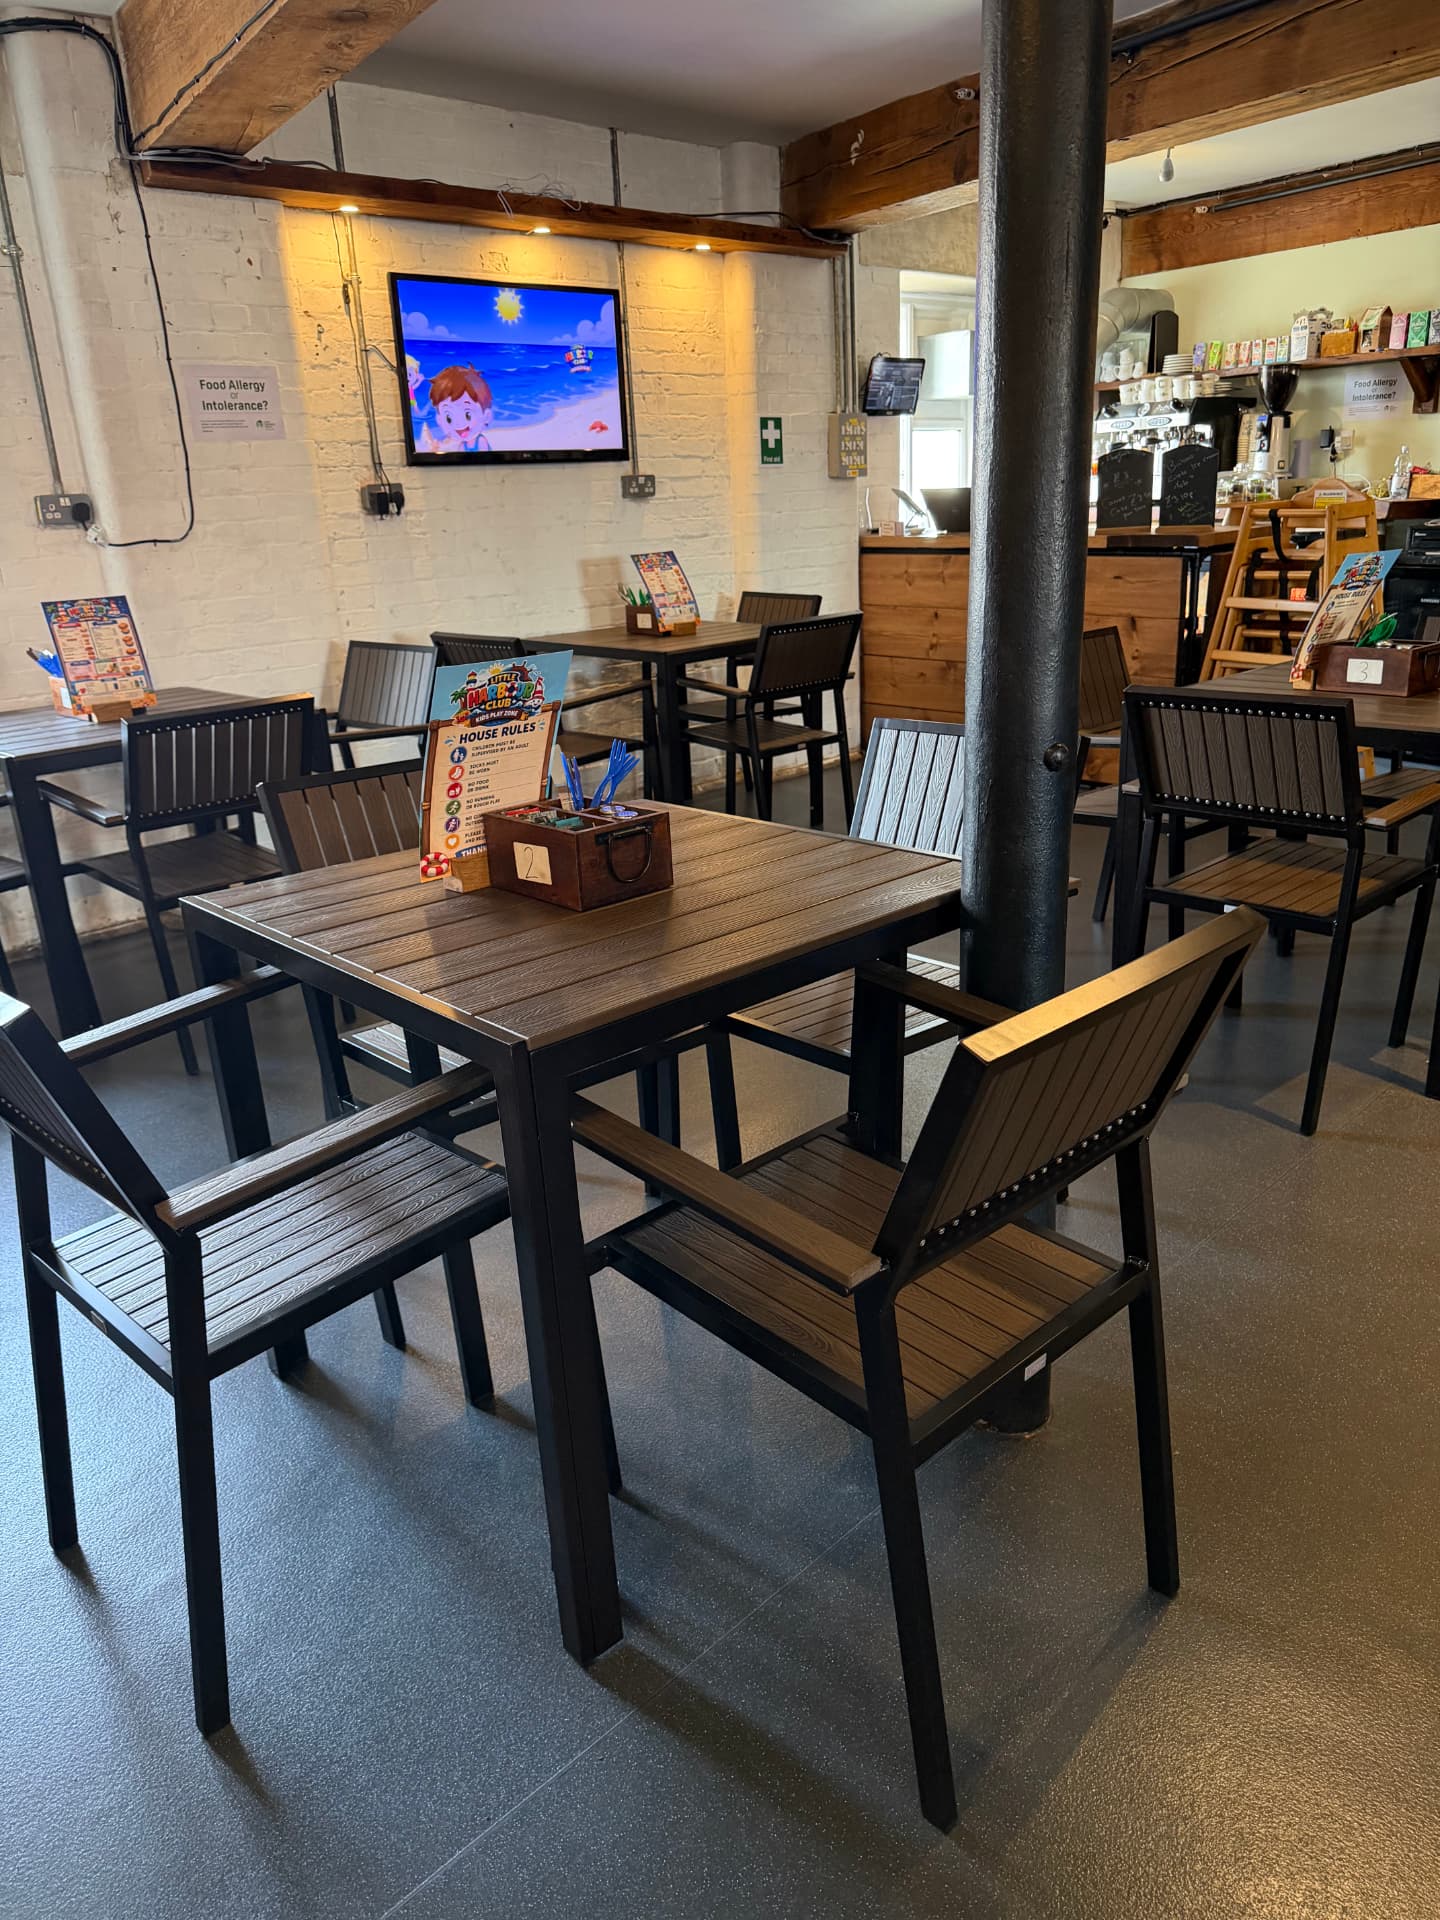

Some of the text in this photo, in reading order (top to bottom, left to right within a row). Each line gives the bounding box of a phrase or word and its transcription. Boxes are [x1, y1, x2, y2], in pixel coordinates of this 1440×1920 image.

[199, 379, 265, 392] Food Allergy
[1354, 378, 1398, 388] Food Allergy
[1352, 391, 1396, 401] Intolerance?
[202, 400, 269, 411] Intolerance?
[1360, 661, 1369, 681] 3
[489, 672, 517, 684] LITTLE
[467, 682, 534, 709] HARBOUR
[485, 698, 512, 710] CLUB
[475, 712, 490, 723] KIDS
[489, 710, 503, 719] PLAY
[459, 722, 536, 744] HOUSE RULES
[471, 743, 495, 751] CHILDREN
[471, 749, 500, 757] SUPERVISED
[464, 830, 482, 838] PLEASE
[523, 846, 539, 879] 2
